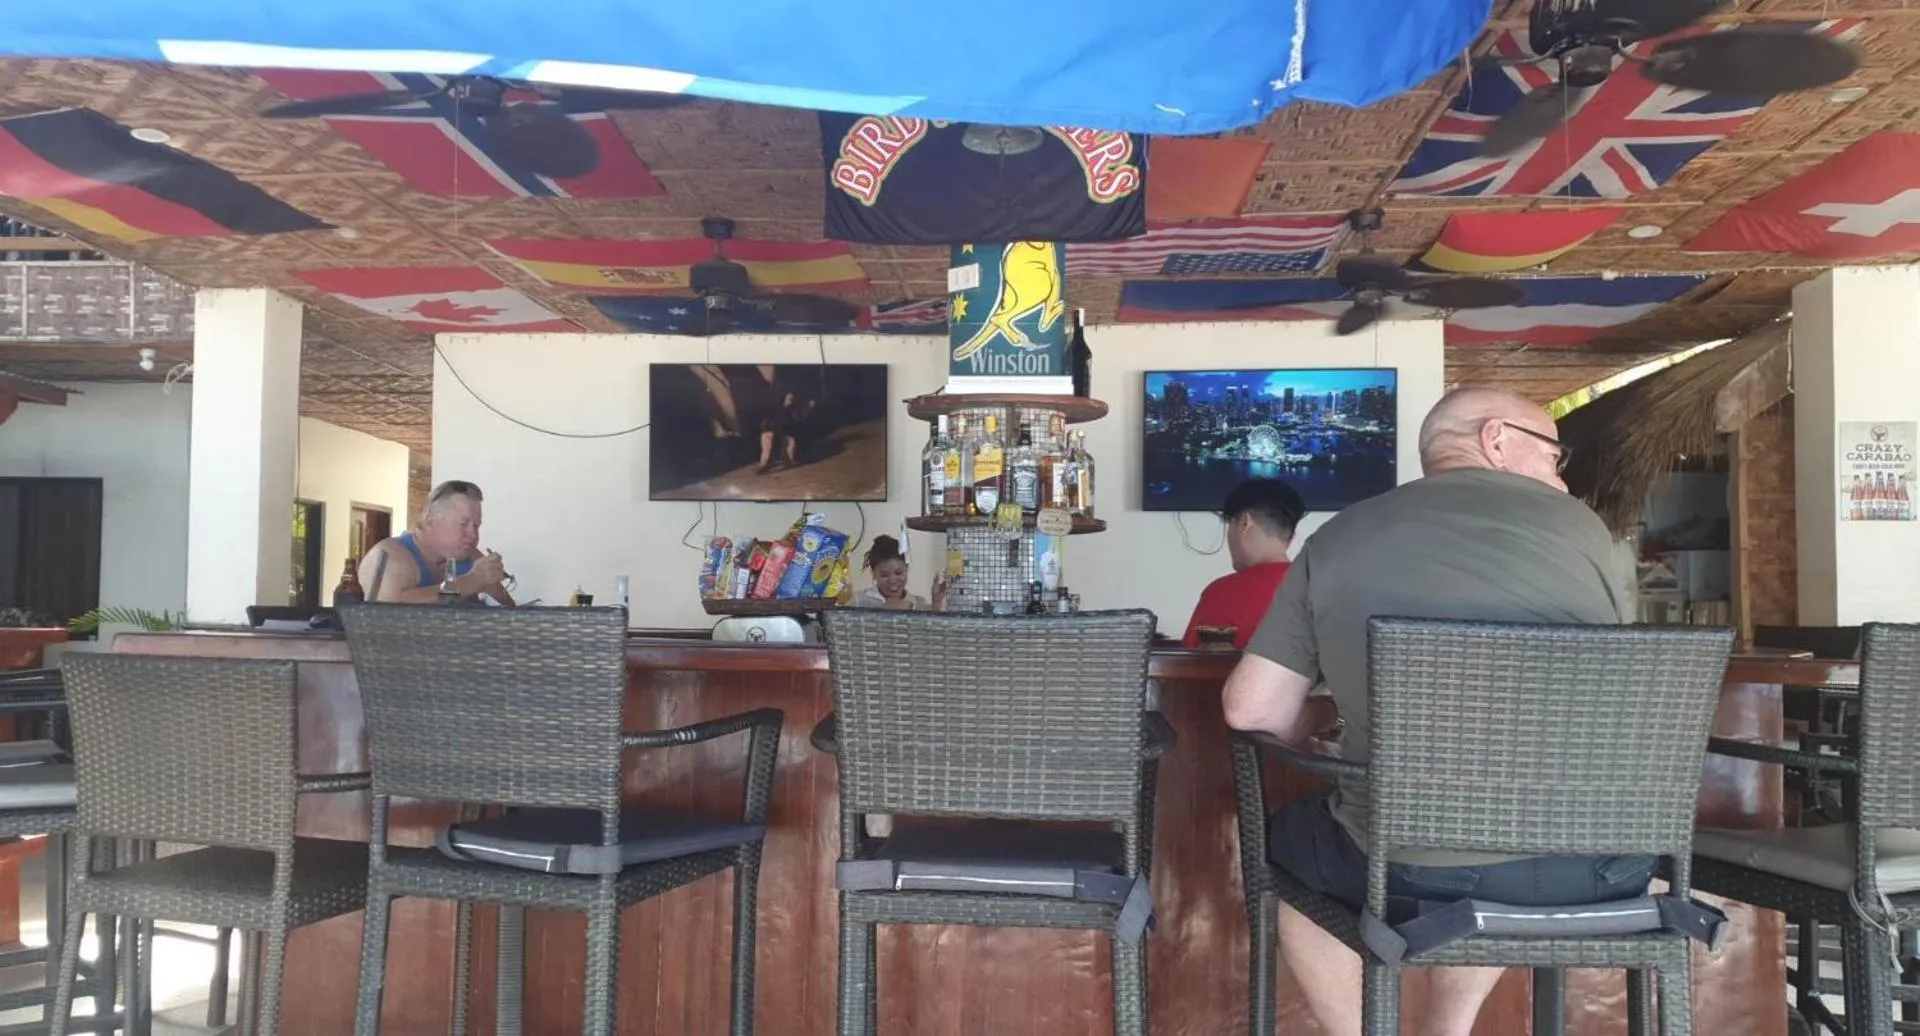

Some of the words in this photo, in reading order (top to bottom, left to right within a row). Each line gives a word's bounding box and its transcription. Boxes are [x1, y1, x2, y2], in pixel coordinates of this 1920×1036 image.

[970, 345, 1050, 374] Winston
[1855, 443, 1904, 453] CRAZY
[1846, 452, 1912, 461] CARABAO
